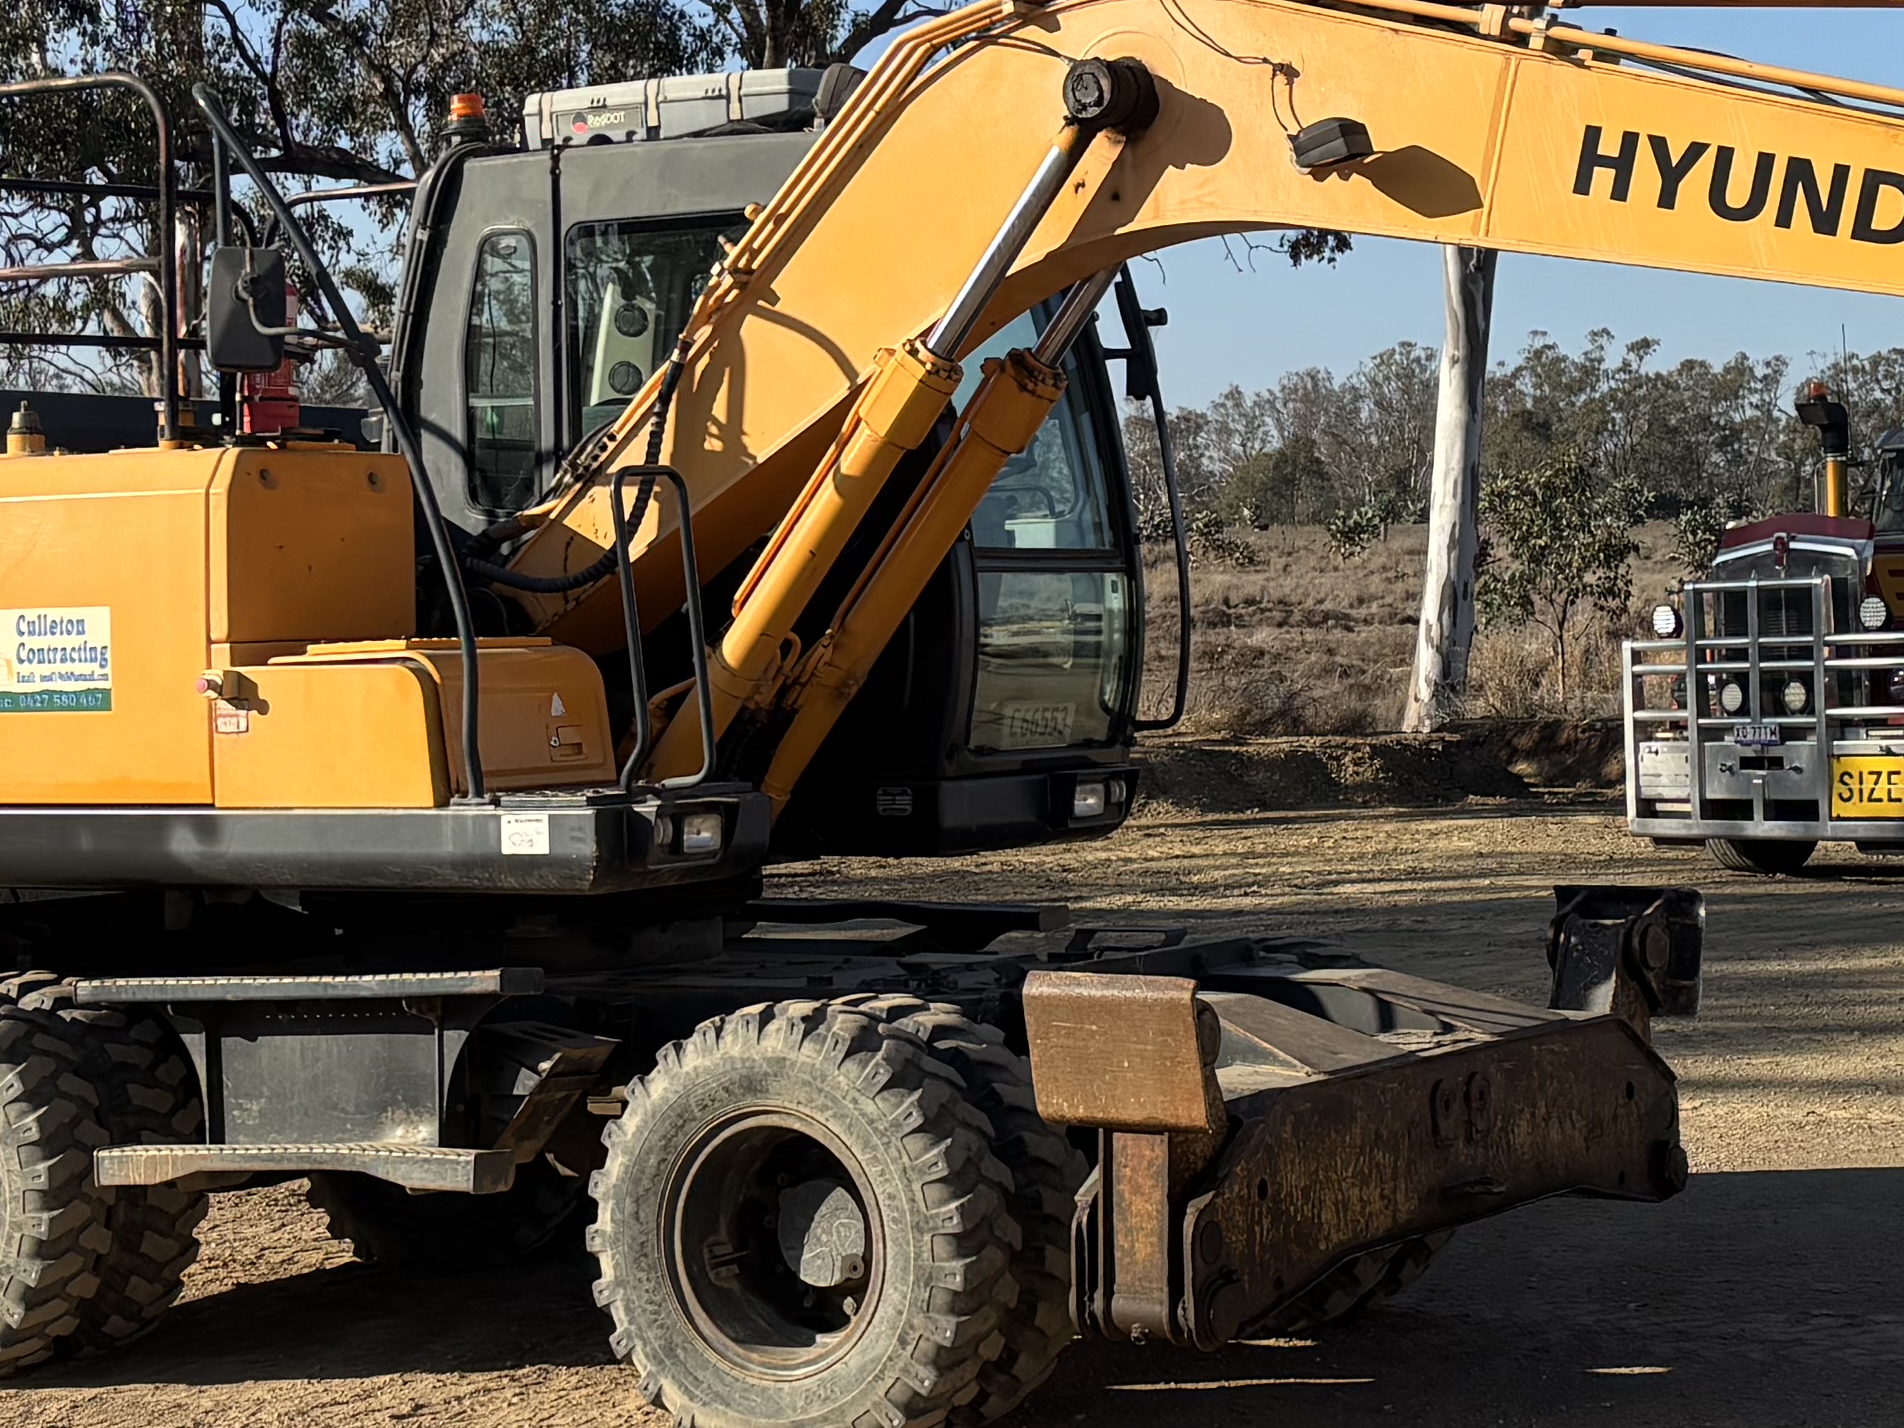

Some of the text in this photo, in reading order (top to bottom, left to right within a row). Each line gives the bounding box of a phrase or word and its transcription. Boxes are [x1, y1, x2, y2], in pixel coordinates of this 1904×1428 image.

[16, 614, 86, 637] Culleton
[16, 640, 108, 669] Contracting
[19, 694, 48, 707] 0427
[53, 694, 76, 707] 580
[1838, 771, 1902, 803] SIZE
